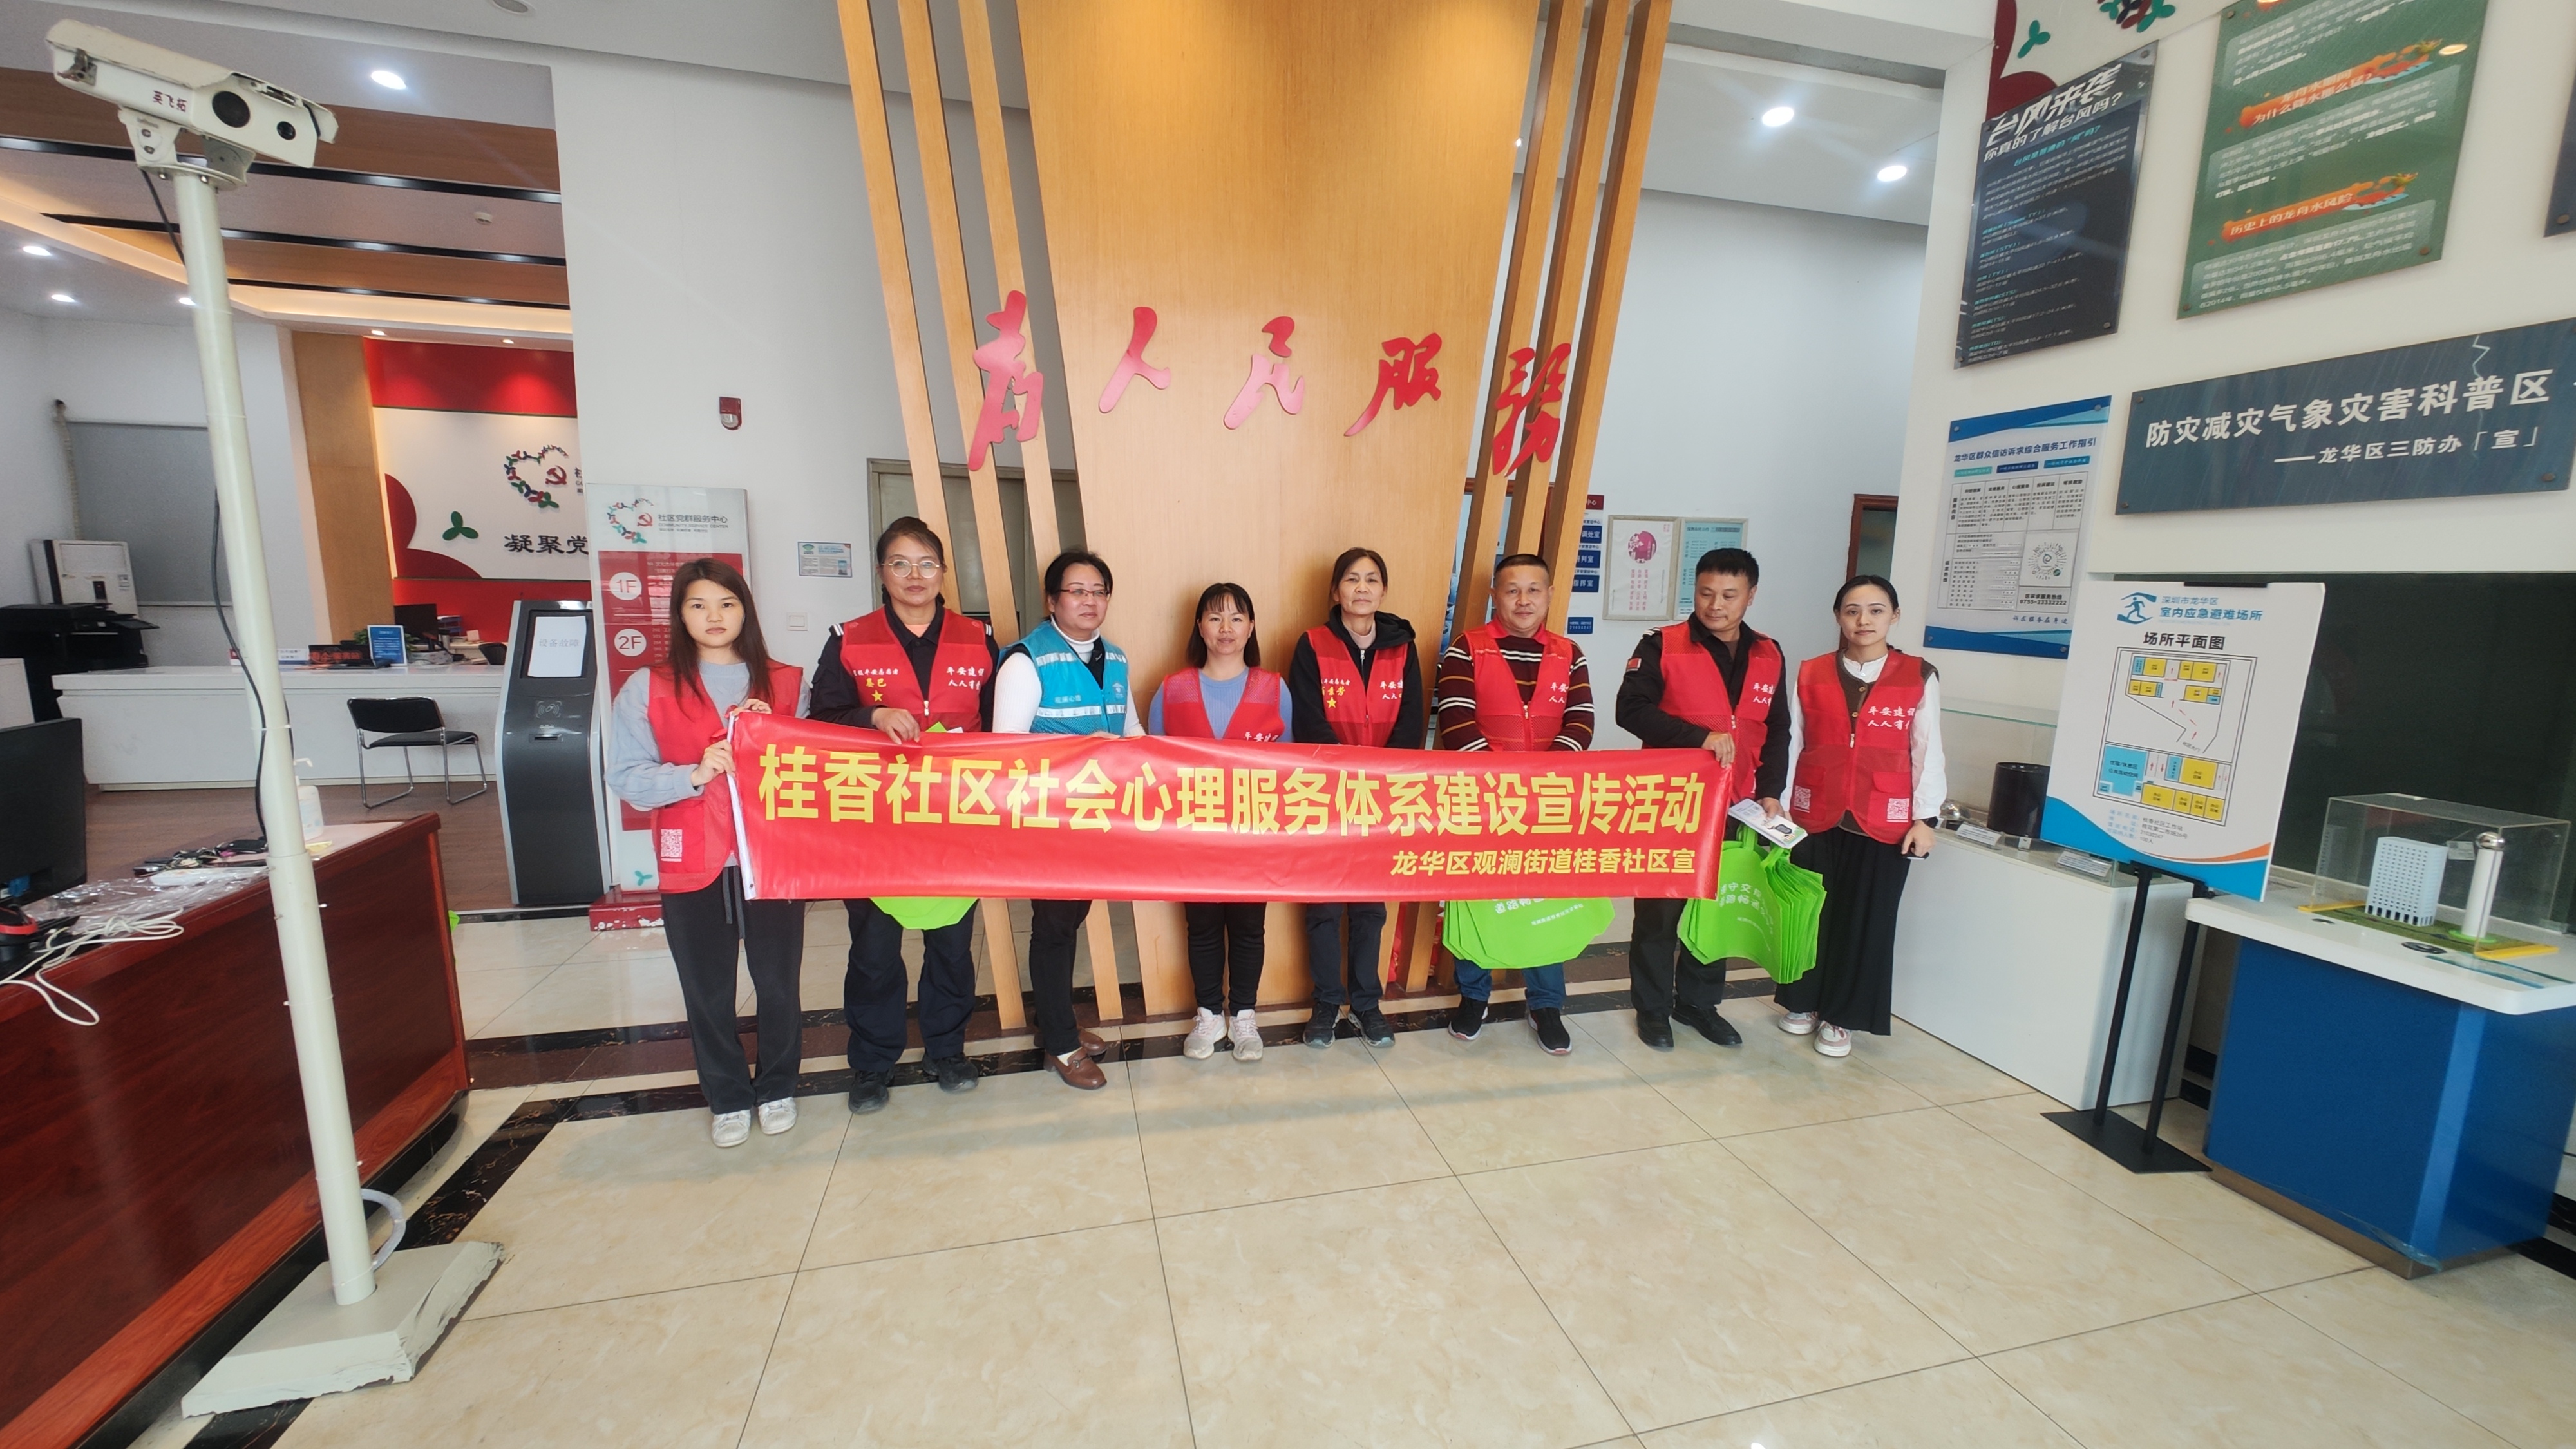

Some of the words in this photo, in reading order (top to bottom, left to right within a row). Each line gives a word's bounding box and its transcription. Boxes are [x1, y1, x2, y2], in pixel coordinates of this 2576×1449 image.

[153, 90, 187, 112] 英飞拓
[2230, 193, 2354, 236] 历史上的龙舟水风险
[2145, 369, 2554, 448] 防灾减灾气象灾害科普区
[1954, 437, 2097, 462] 龙华区群众信访诉求综合服务工作指引
[658, 514, 728, 523] 社区党群服务中心
[504, 534, 589, 556] 凝聚党
[615, 580, 638, 594] 1F
[2161, 596, 2219, 605] 深圳市龙华区
[2159, 607, 2263, 621] 室内应急避难场所
[539, 638, 580, 647] 设备故障
[618, 635, 642, 650] 2F
[2143, 631, 2226, 650] 场所平面图
[1867, 719, 1910, 730] 人人有
[759, 743, 1705, 837] 桂香社区社会心理服务体系建设宣传活动
[1391, 848, 1695, 876] 龙华区观澜街道桂香社区宣
